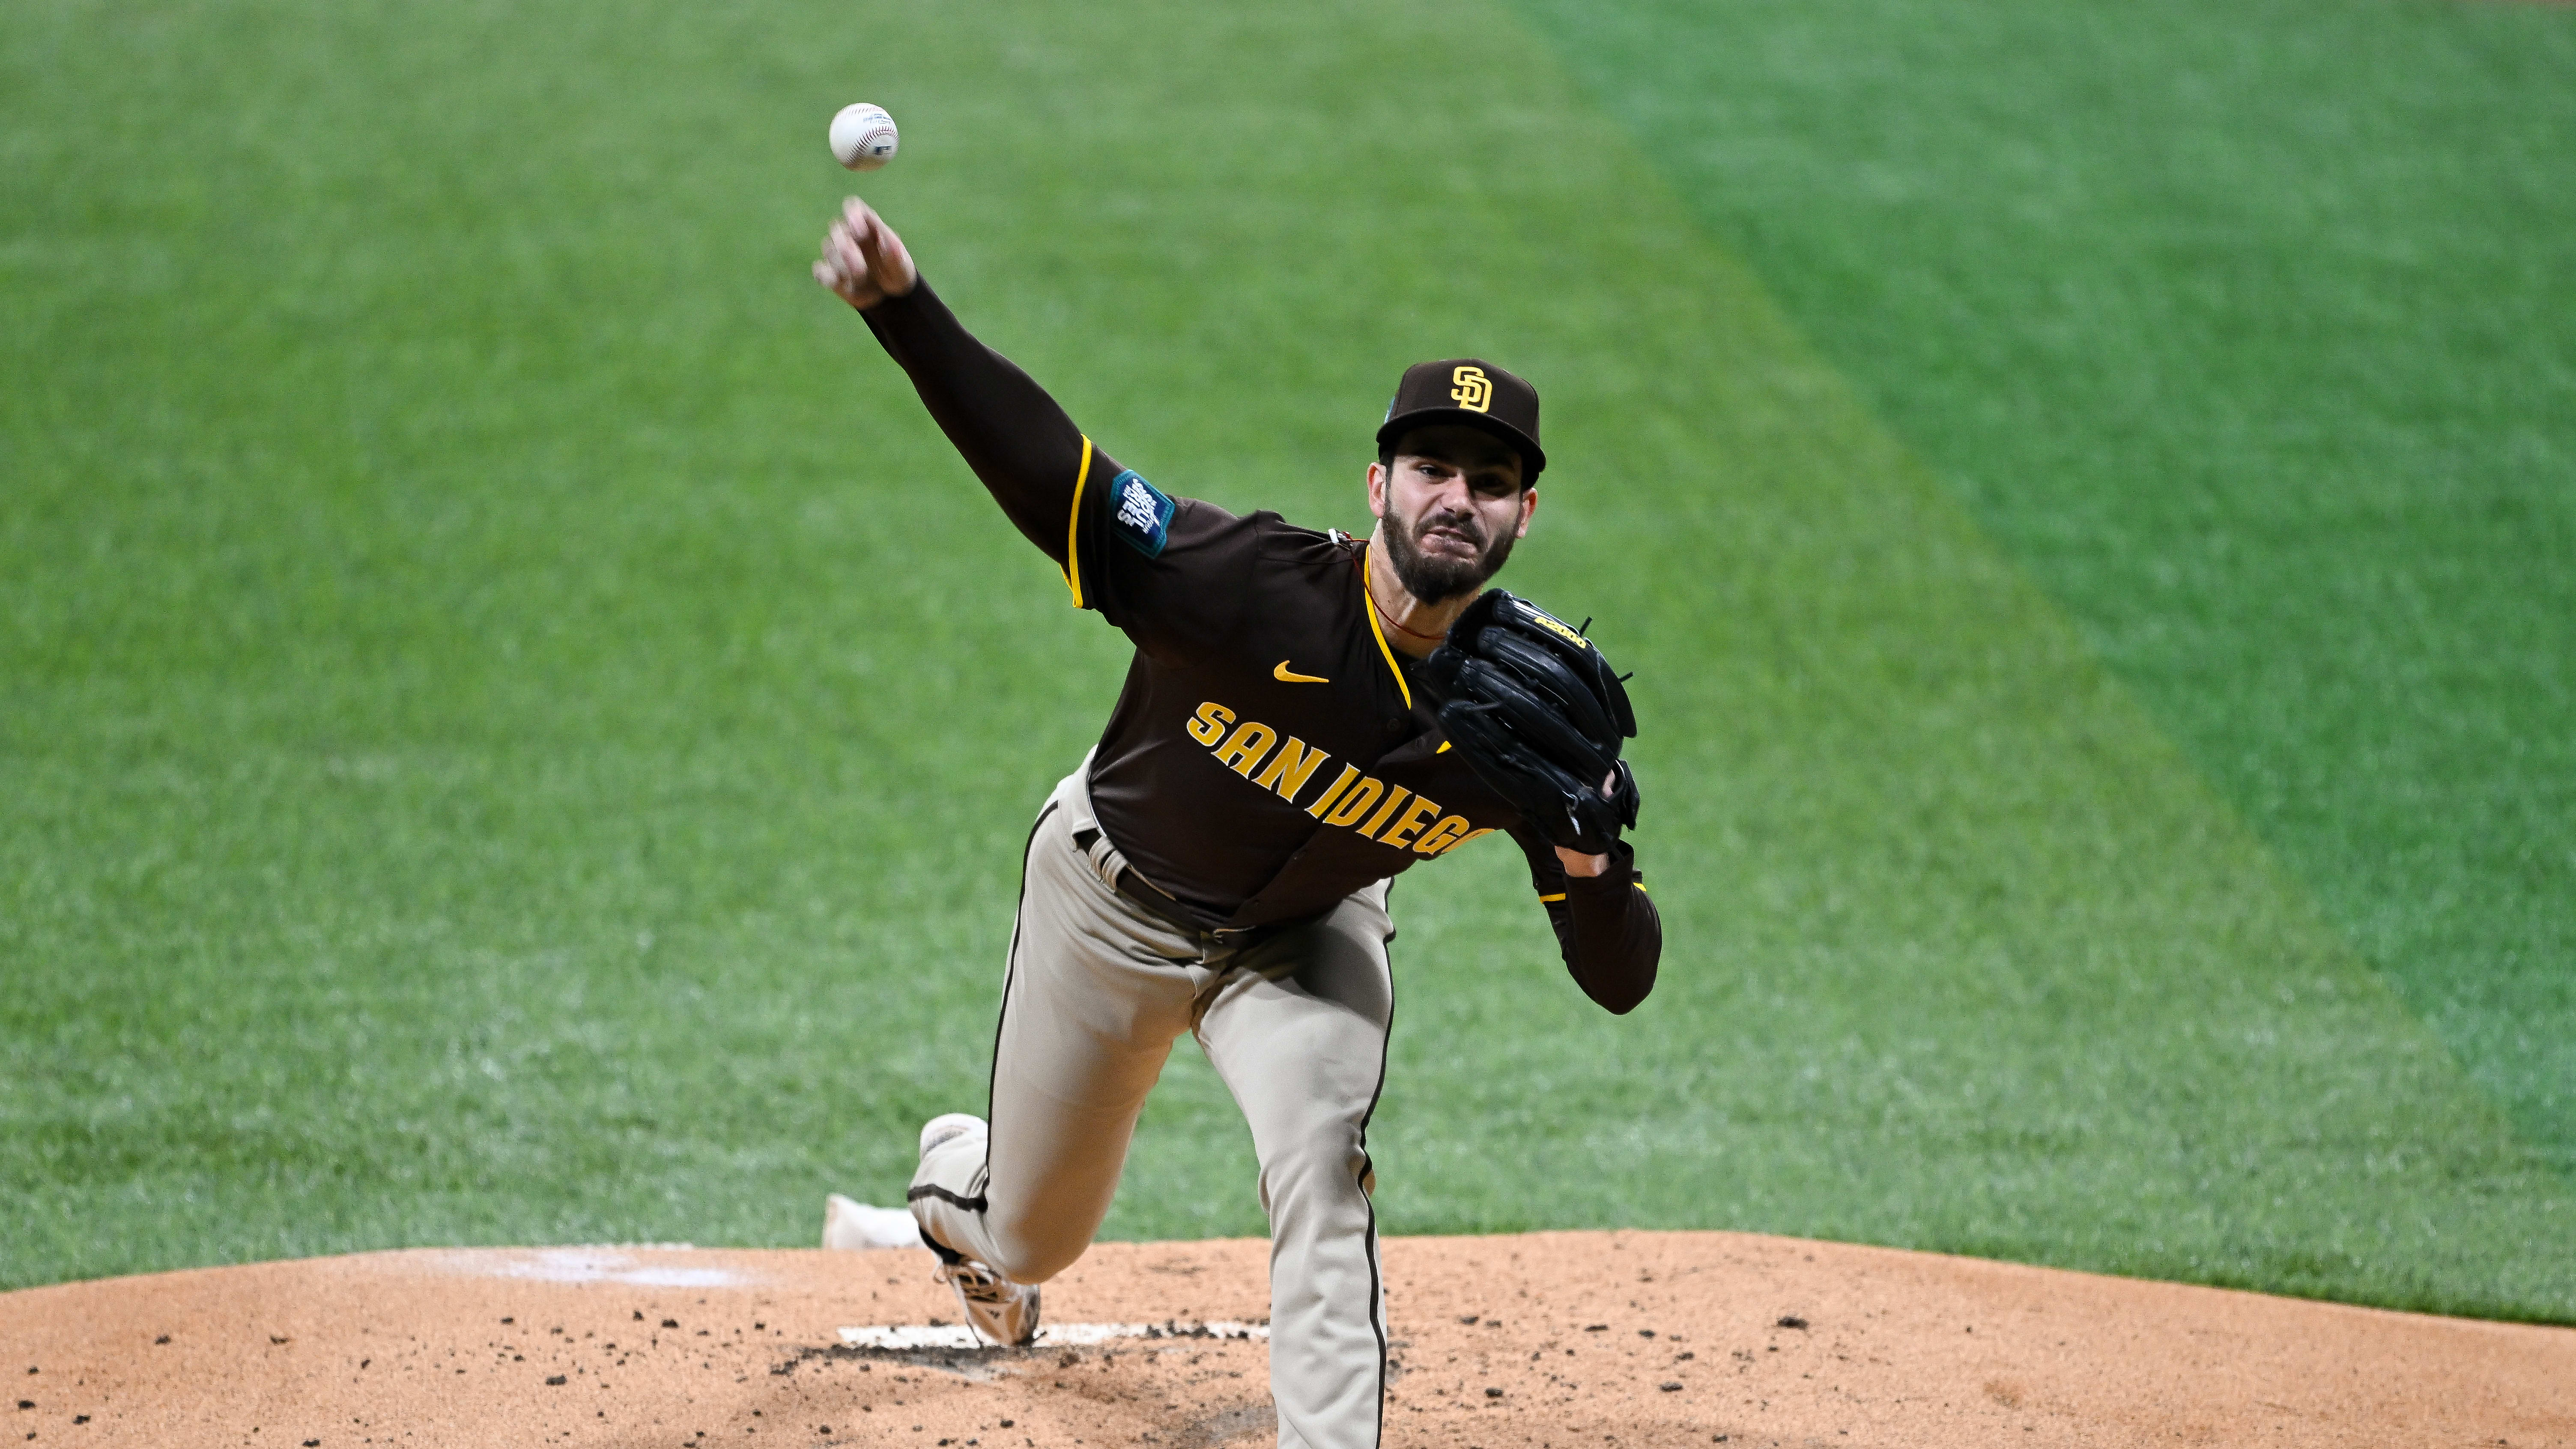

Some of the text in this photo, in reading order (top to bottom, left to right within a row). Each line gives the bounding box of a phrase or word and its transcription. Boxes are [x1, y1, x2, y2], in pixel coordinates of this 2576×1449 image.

[1451, 366, 1493, 413] SD
[1534, 616, 1586, 648] A2000
[1186, 701, 1331, 804] SAN
